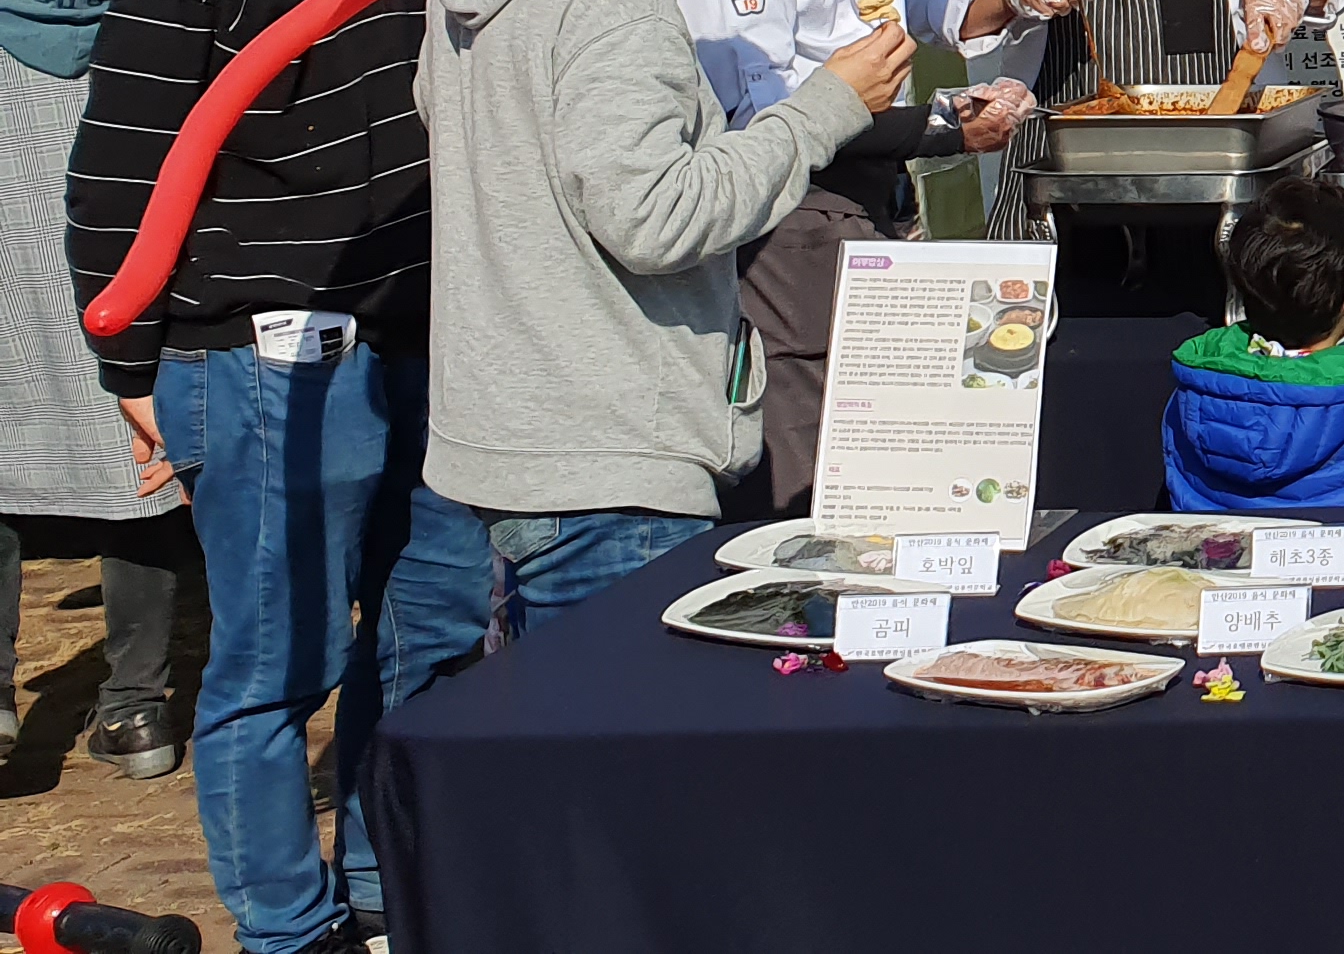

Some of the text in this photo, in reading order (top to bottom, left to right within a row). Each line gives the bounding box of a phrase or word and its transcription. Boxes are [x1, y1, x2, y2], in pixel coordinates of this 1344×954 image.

[744, 0, 758, 11] 19
[918, 556, 974, 576] 호박잎
[1269, 548, 1333, 568] 해초3종
[872, 618, 911, 638] 곰피
[1224, 611, 1282, 633] 양배추
